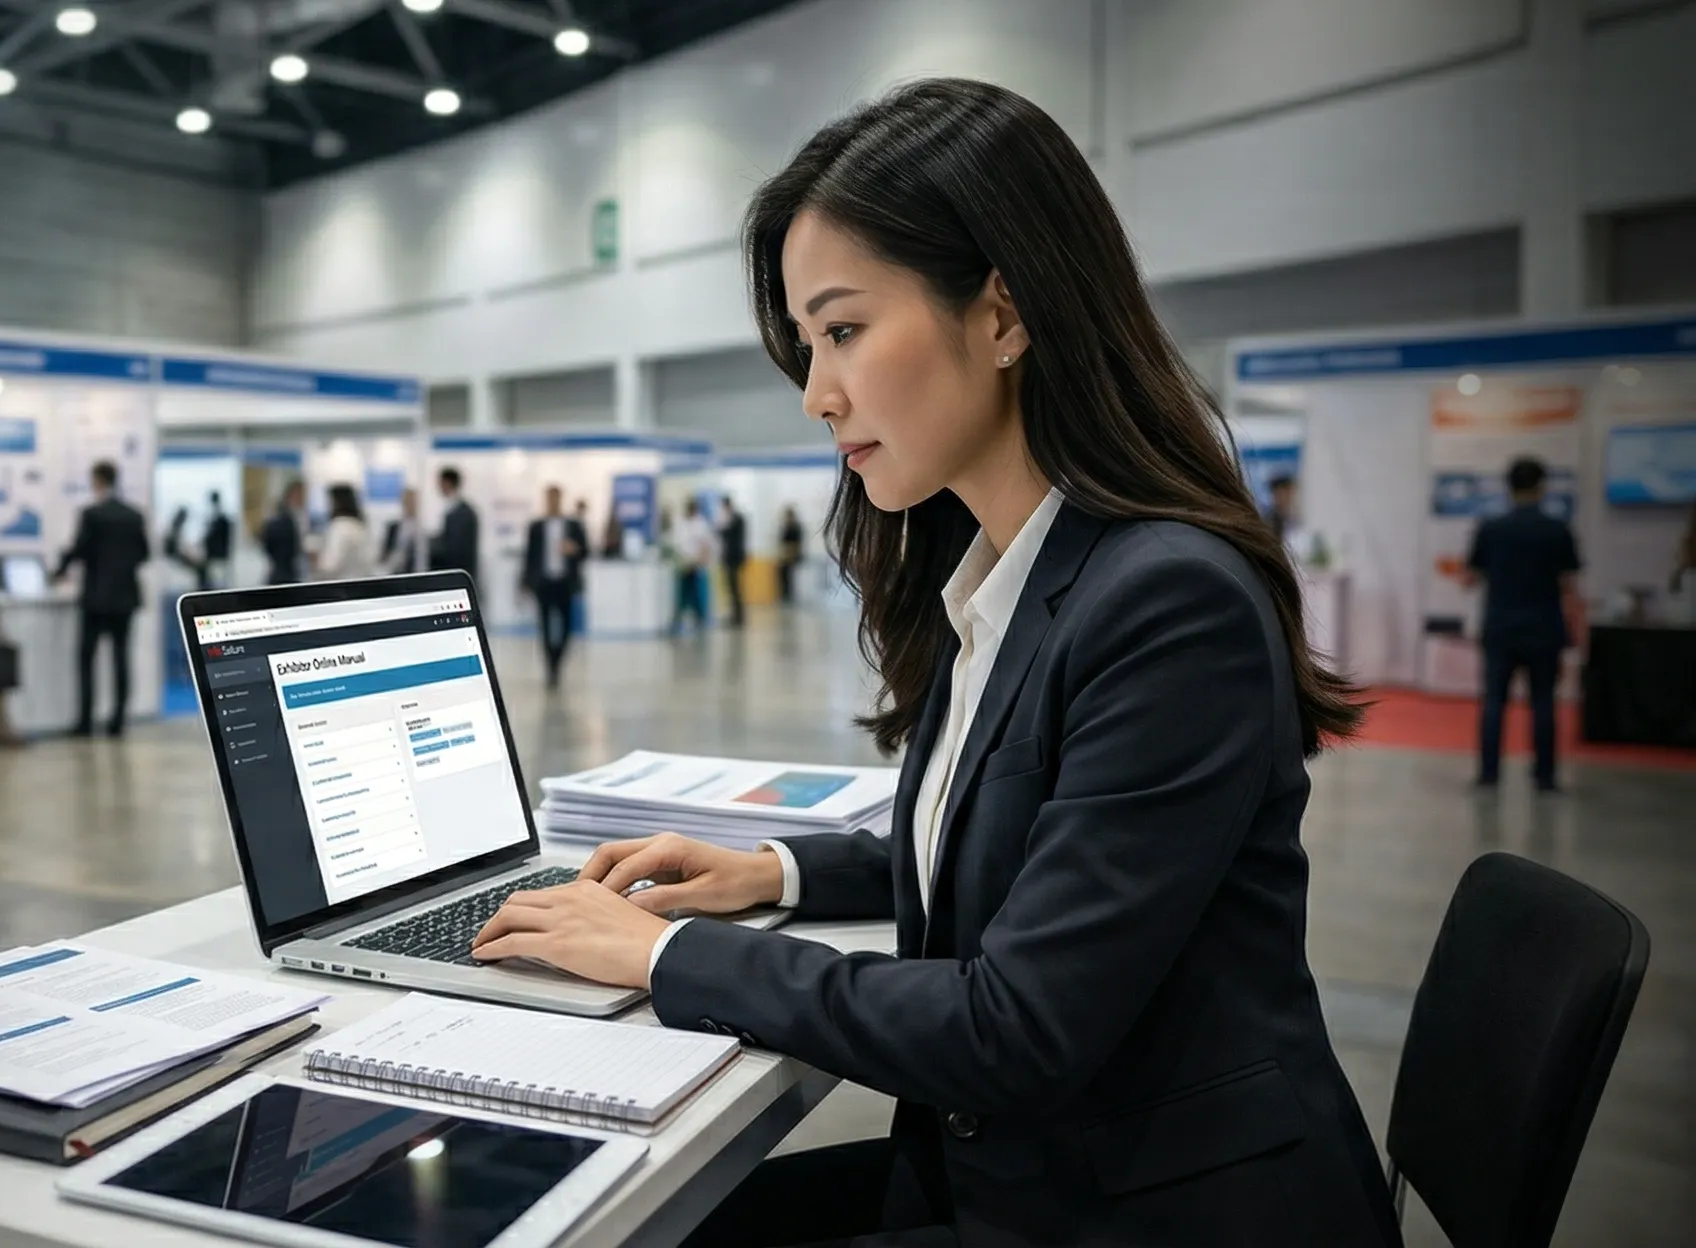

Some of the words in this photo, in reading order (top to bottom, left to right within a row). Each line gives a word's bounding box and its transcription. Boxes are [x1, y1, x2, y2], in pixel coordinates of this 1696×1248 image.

[277, 661, 311, 676] Exhibitor
[313, 656, 338, 670] Online
[339, 651, 365, 665] Manual
